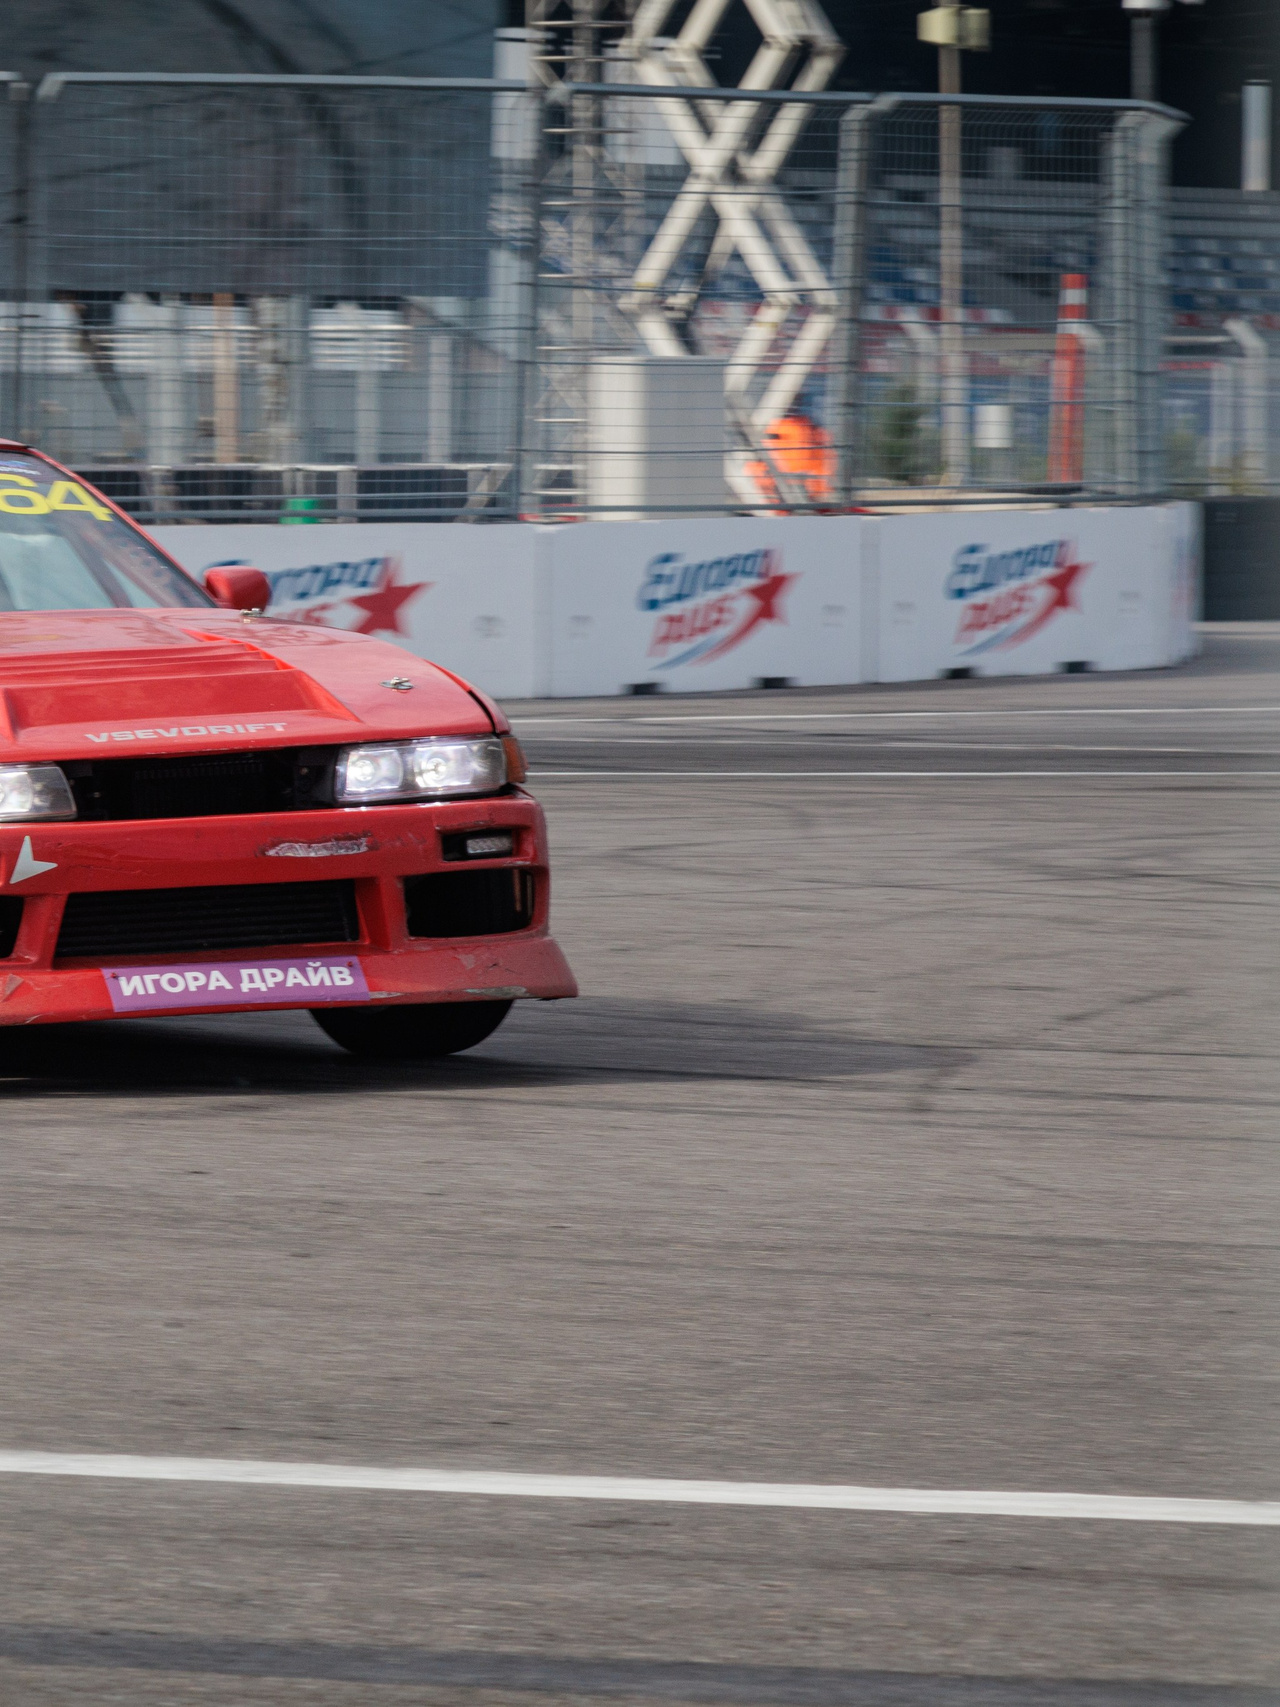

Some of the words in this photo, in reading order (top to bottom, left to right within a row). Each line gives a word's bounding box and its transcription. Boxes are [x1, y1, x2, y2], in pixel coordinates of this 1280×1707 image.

[84, 722, 287, 743] VSEVDRIFT
[119, 970, 233, 996] ИГОРА
[239, 962, 354, 992] ДРАЙВ
